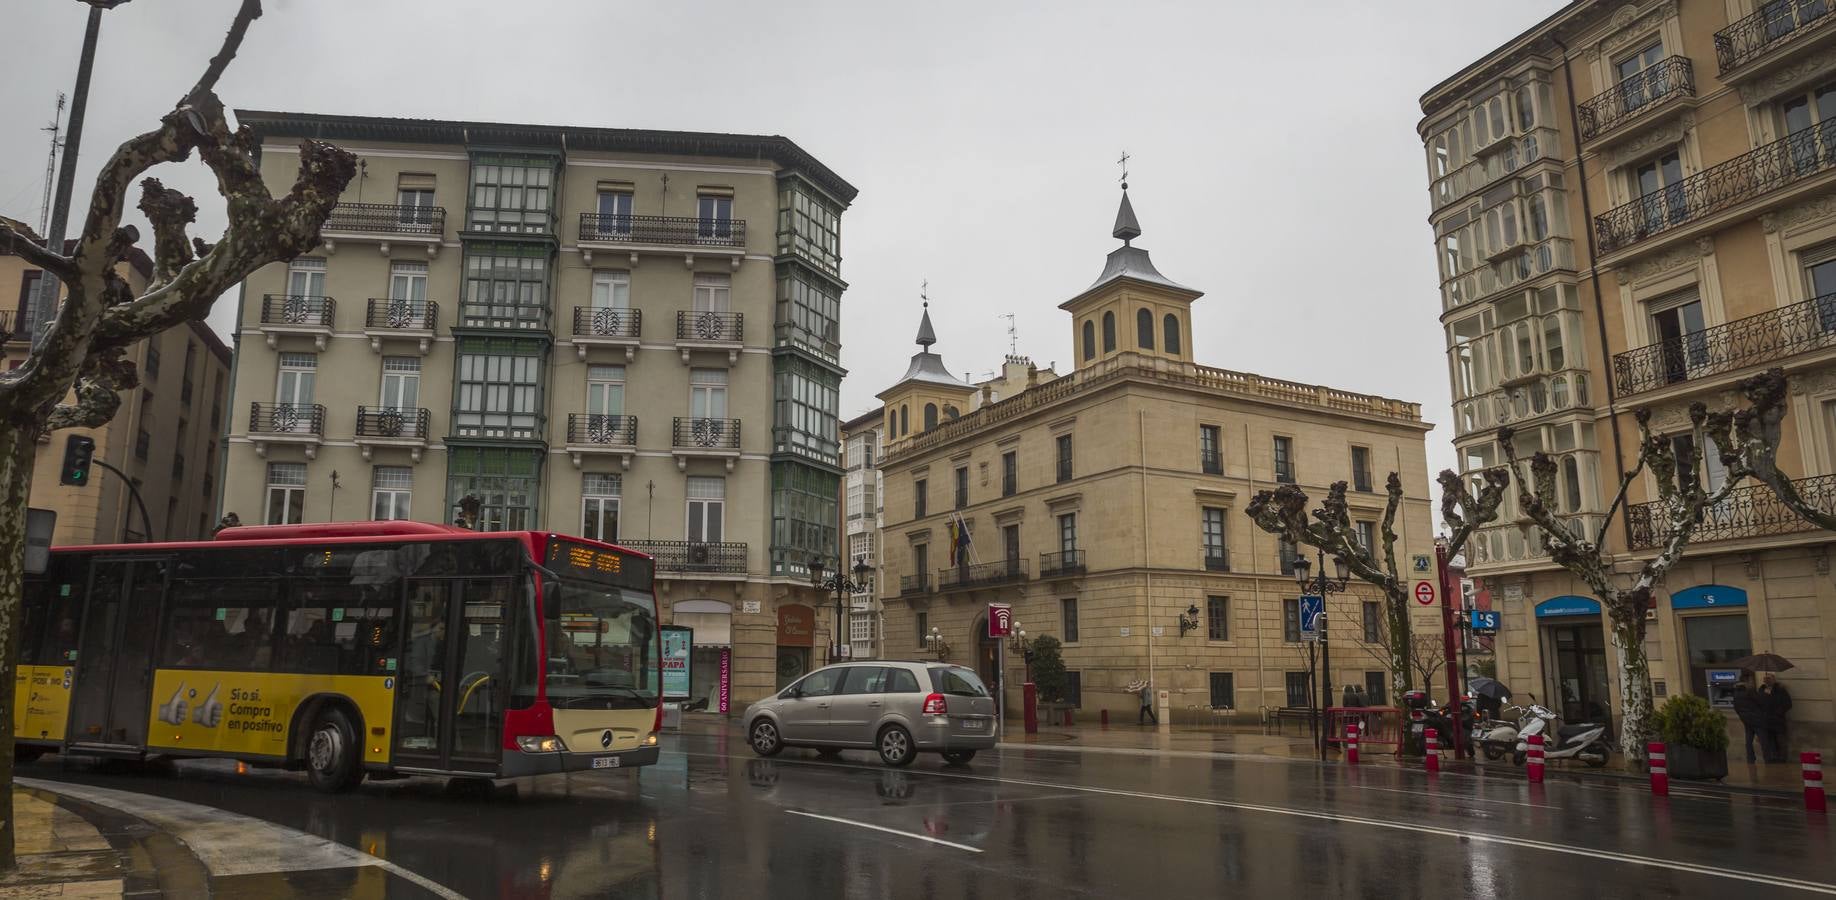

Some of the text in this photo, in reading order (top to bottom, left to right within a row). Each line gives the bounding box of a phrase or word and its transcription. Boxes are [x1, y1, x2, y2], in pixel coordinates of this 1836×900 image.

[720, 650, 728, 712] 60 ANIVERSARIO
[230, 703, 271, 719] Compra
[228, 720, 241, 729] en
